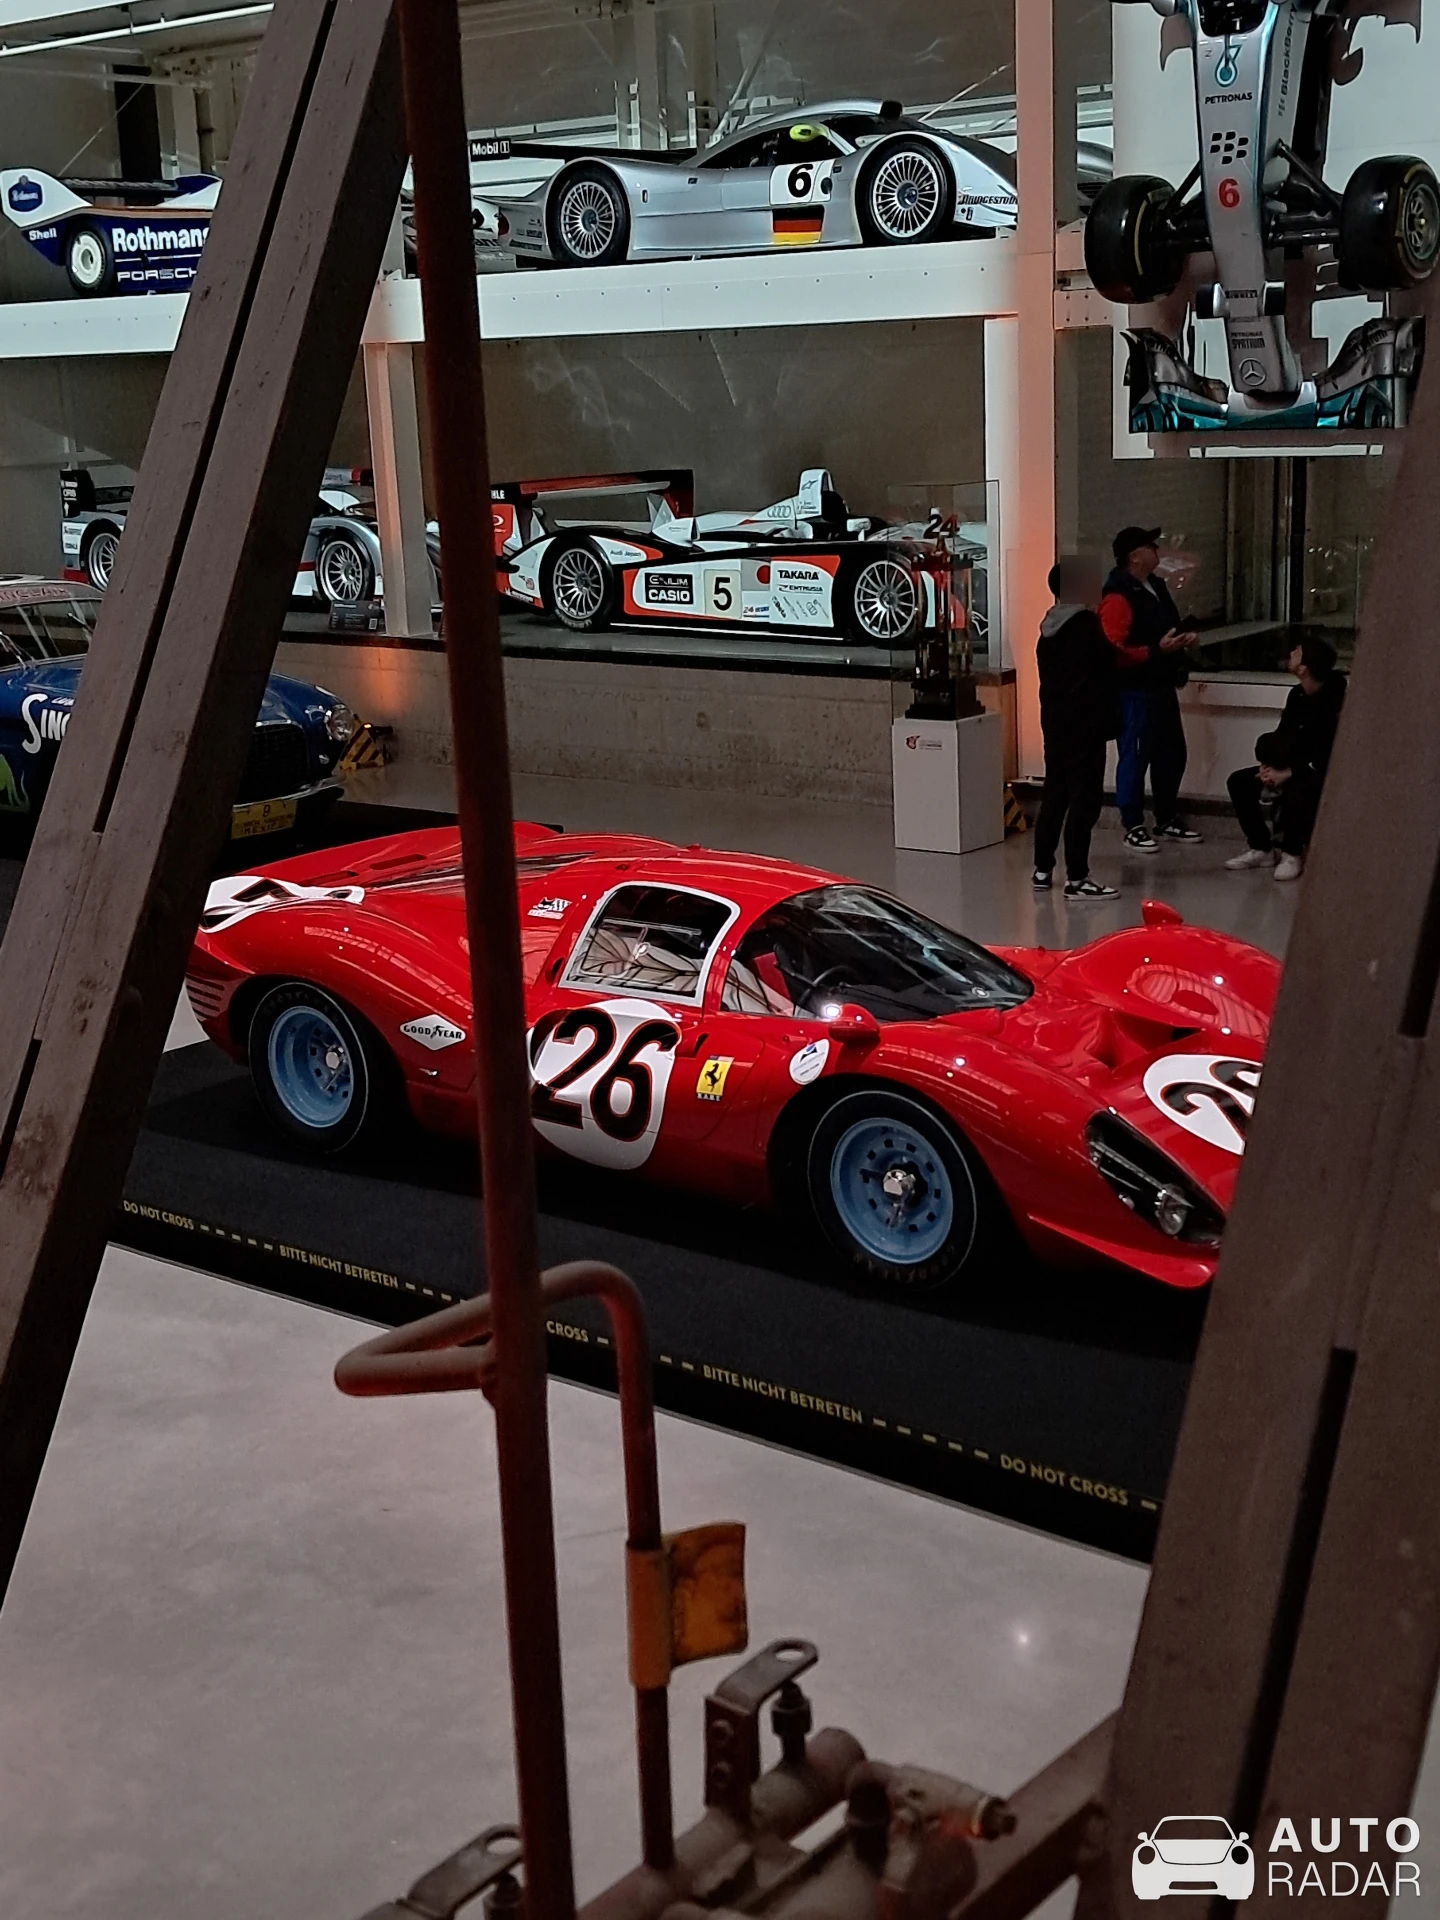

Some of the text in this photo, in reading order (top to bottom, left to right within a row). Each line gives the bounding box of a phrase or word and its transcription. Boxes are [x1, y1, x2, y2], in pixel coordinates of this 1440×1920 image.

[1205, 92, 1253, 104] PETRONAS
[472, 142, 499, 155] Mobil
[788, 164, 814, 198] 6
[1218, 178, 1240, 208] 6
[958, 195, 1018, 205] BRIDGESTON
[29, 228, 57, 241] Shell
[117, 267, 197, 282] PORSCH
[491, 490, 505, 499] HLE
[923, 512, 959, 539] 24
[777, 570, 819, 580] TAKARA
[648, 589, 690, 602] CASIO
[713, 577, 732, 611] 5
[530, 1007, 682, 1142] 26
[123, 1200, 194, 1230] DO NOT CROSS
[279, 1245, 398, 1289] BITTE NICHT BETRETEN
[546, 1320, 589, 1342] CROSS
[703, 1364, 863, 1424] BITTE NICHT BETRETEN
[1000, 1454, 1128, 1506] DO NOT CROSS
